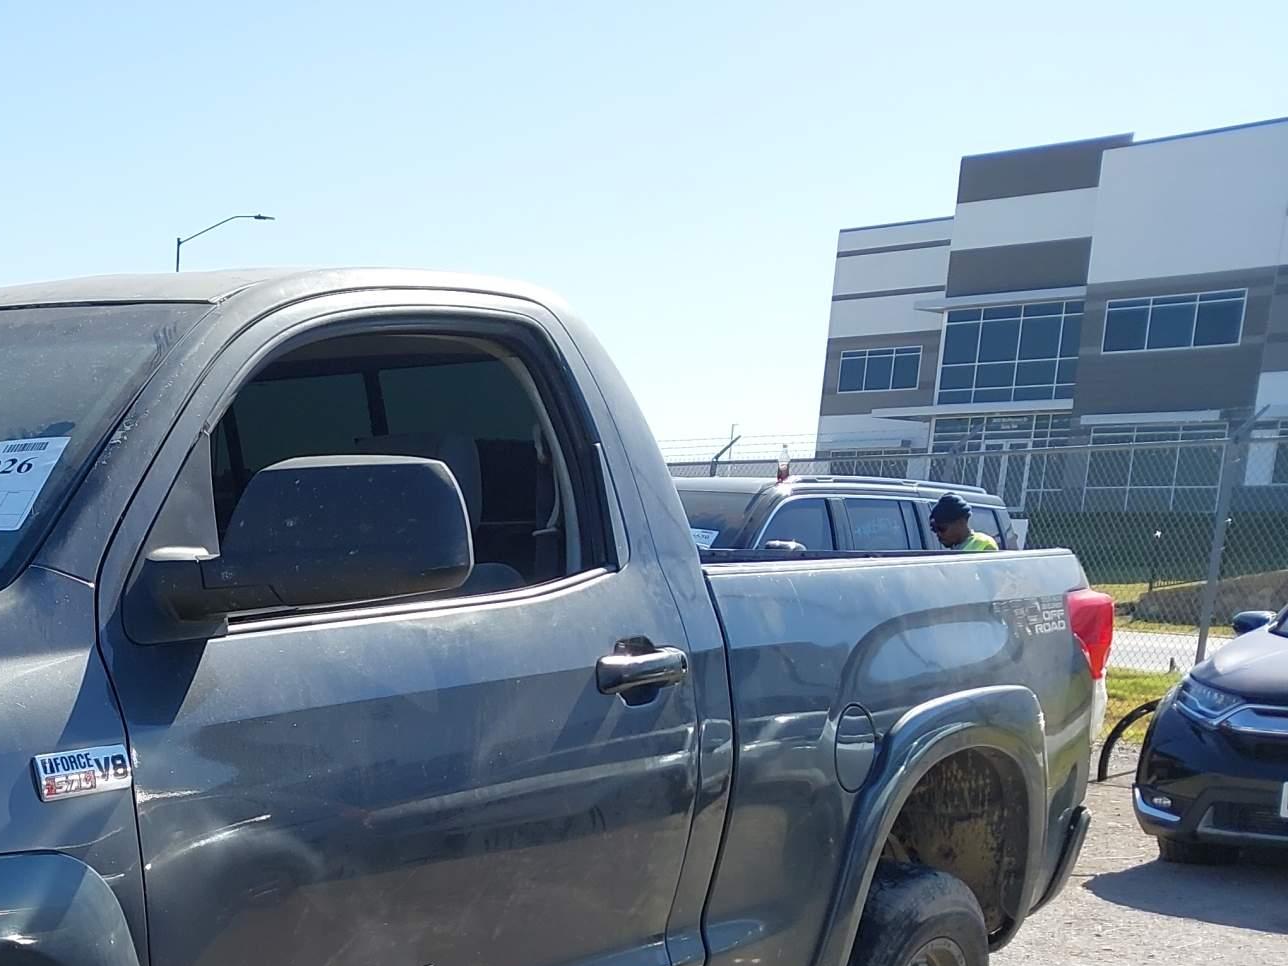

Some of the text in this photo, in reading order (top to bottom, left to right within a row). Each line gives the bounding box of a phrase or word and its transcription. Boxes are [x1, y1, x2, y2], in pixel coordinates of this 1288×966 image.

[1042, 609, 1065, 621] OFF
[1034, 620, 1066, 634] ROAD
[94, 754, 129, 781] V8
